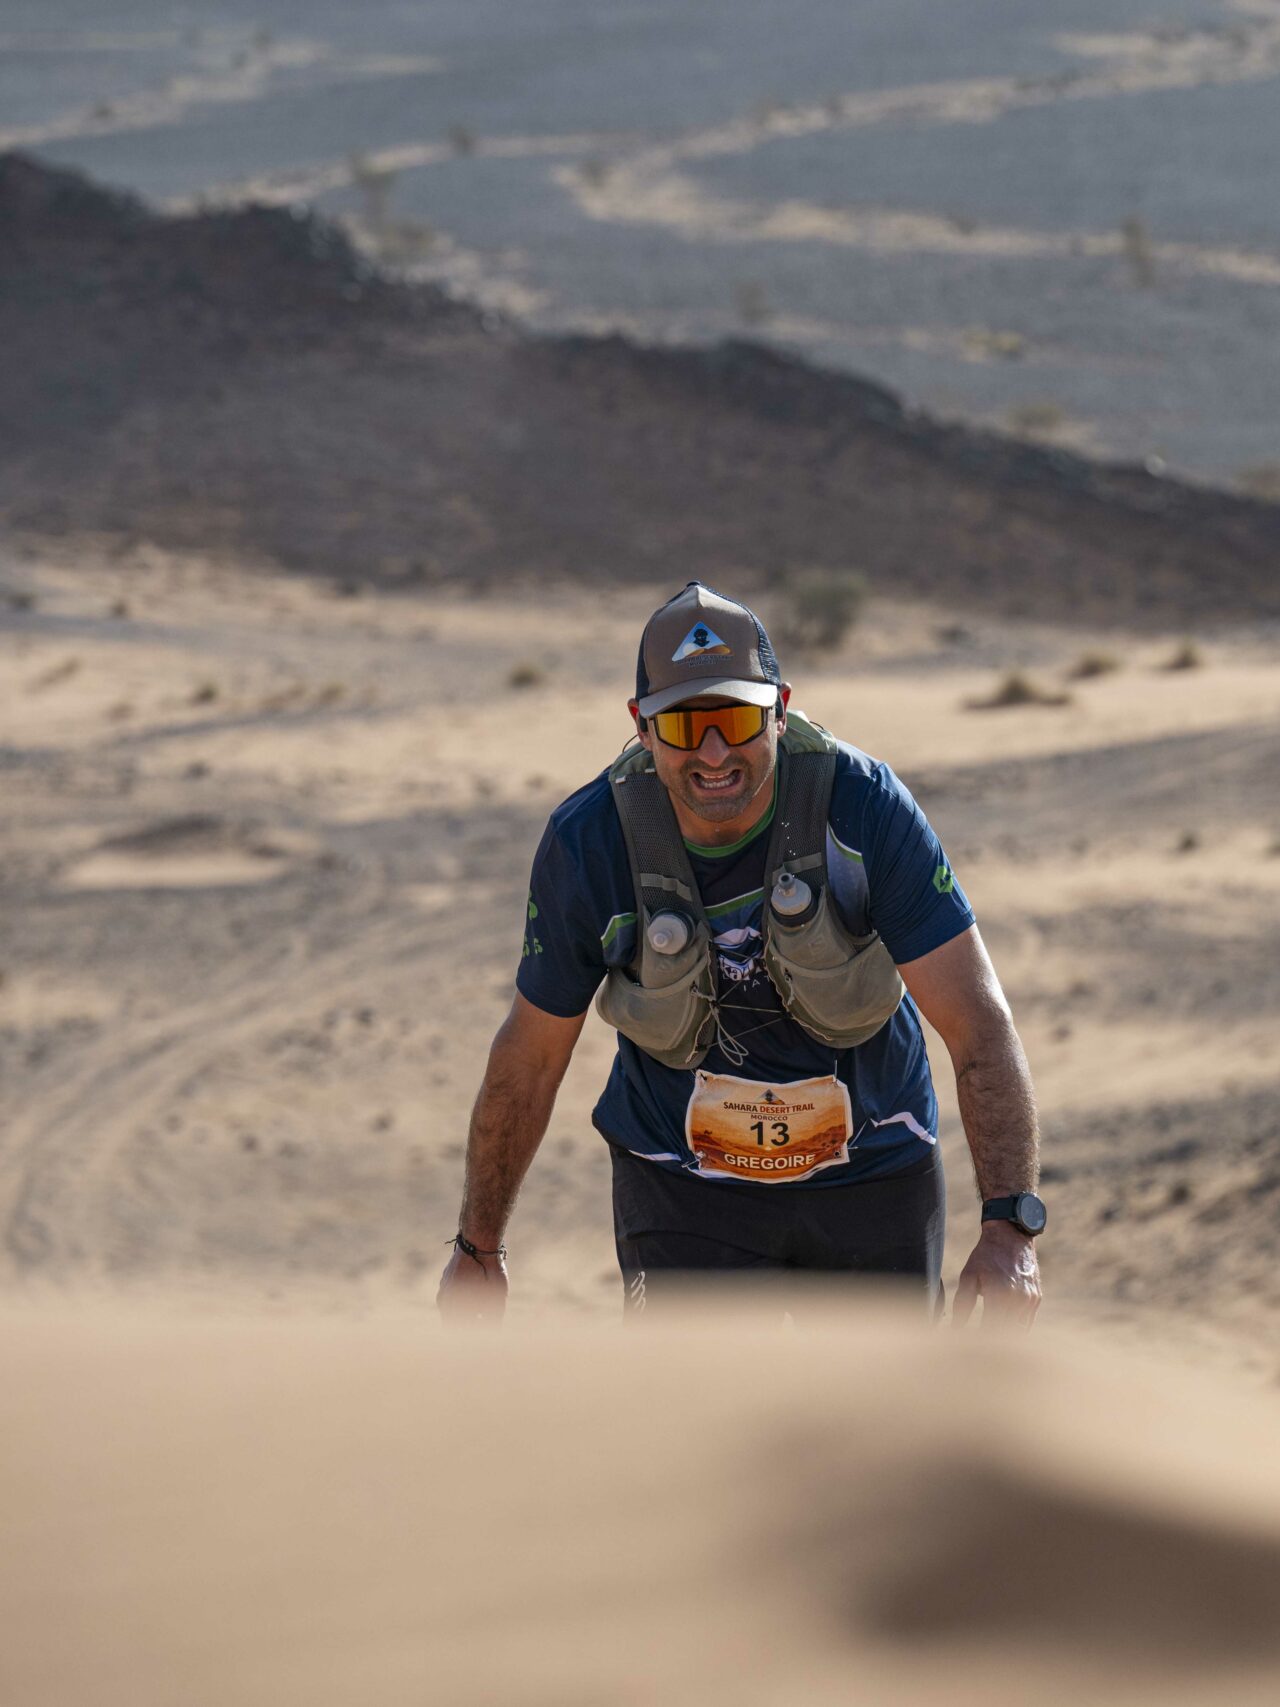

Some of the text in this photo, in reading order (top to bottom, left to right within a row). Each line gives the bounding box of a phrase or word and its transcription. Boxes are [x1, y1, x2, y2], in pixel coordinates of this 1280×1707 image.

[723, 1101, 815, 1114] SAHARA DESERT TRAIL
[750, 1121, 790, 1147] 13
[724, 1153, 816, 1170] GREGOIRE
